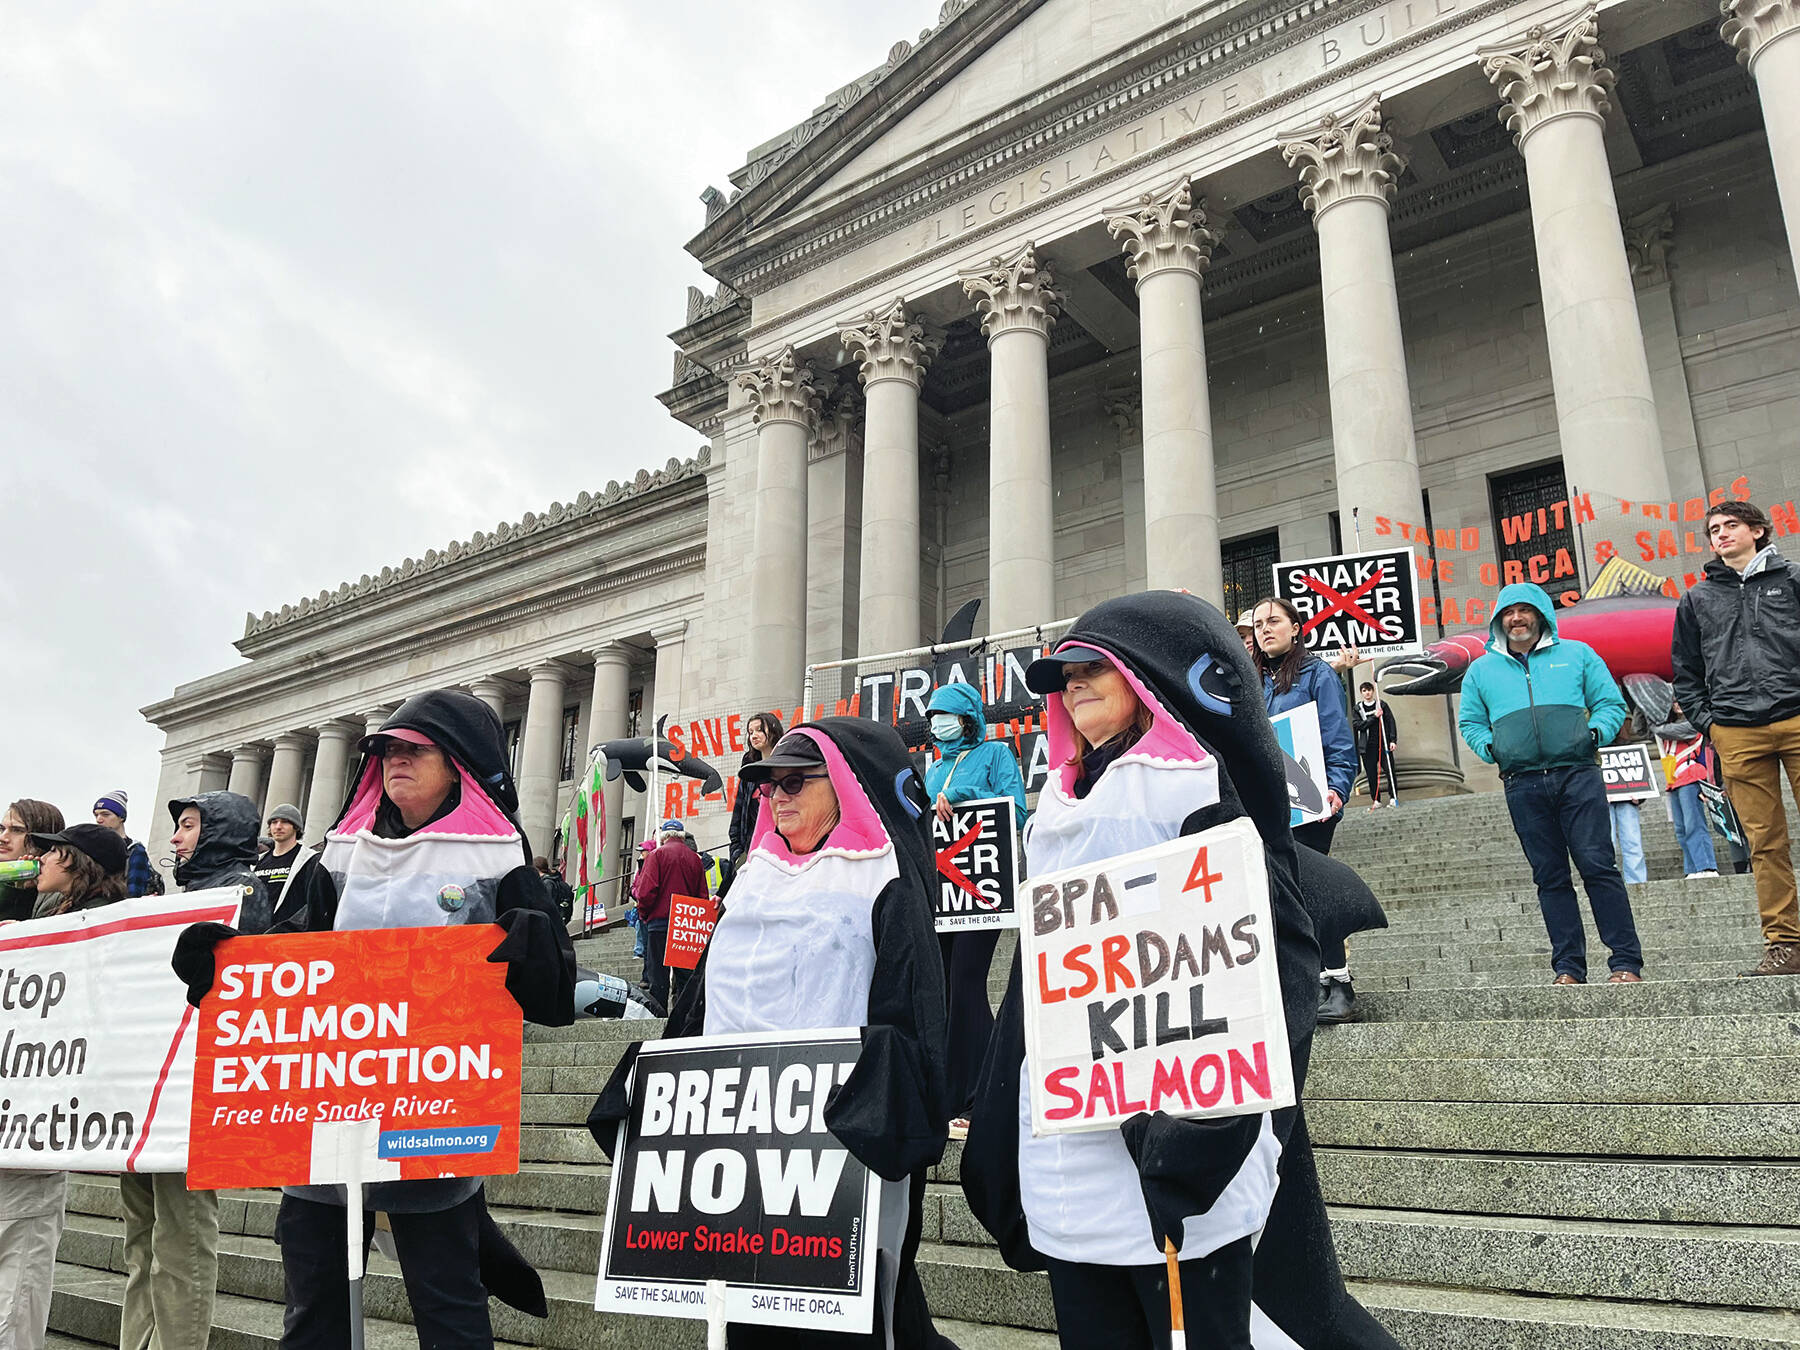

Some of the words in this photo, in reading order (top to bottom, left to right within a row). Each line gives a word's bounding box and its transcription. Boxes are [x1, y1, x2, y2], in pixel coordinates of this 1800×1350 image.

[936, 86, 1245, 240] LEGISLATIVE
[1375, 515, 1479, 551] STAND
[1500, 493, 1595, 546] WITH
[1479, 547, 1575, 587] ORCA
[1638, 500, 1800, 562] SALN
[1288, 557, 1398, 594] SNAKE
[1420, 597, 1496, 626] EAC
[668, 714, 744, 762] SAVE
[937, 843, 1000, 875] ER
[1182, 846, 1223, 903] 4
[675, 903, 706, 917] STOP
[936, 878, 1002, 913] MS
[950, 917, 966, 925] SAVE
[968, 916, 980, 924] THE
[0, 967, 67, 1018] top
[218, 960, 335, 1000] STOP
[214, 1002, 408, 1047] SALMON
[1087, 984, 1229, 1061] KILL
[212, 1043, 504, 1094] EXTINCTION.
[1044, 1041, 1272, 1120] SALMON
[211, 1106, 263, 1127] Free
[270, 1101, 308, 1123] the
[314, 1097, 385, 1121] Snake
[392, 1095, 457, 1118] River.
[387, 1133, 488, 1150] wildsalmon.org
[630, 1148, 849, 1217] NOW
[626, 1223, 690, 1251] Lower
[694, 1225, 764, 1255] Snake
[771, 1228, 843, 1259] Dams
[848, 1217, 860, 1287] DamTRUTH.org
[615, 1286, 639, 1300] SAVE
[641, 1288, 658, 1302] THE
[661, 1289, 707, 1305] SALMON.
[752, 1294, 780, 1310] SAVE
[783, 1297, 805, 1312] THE
[809, 1299, 845, 1316] ORCA.
